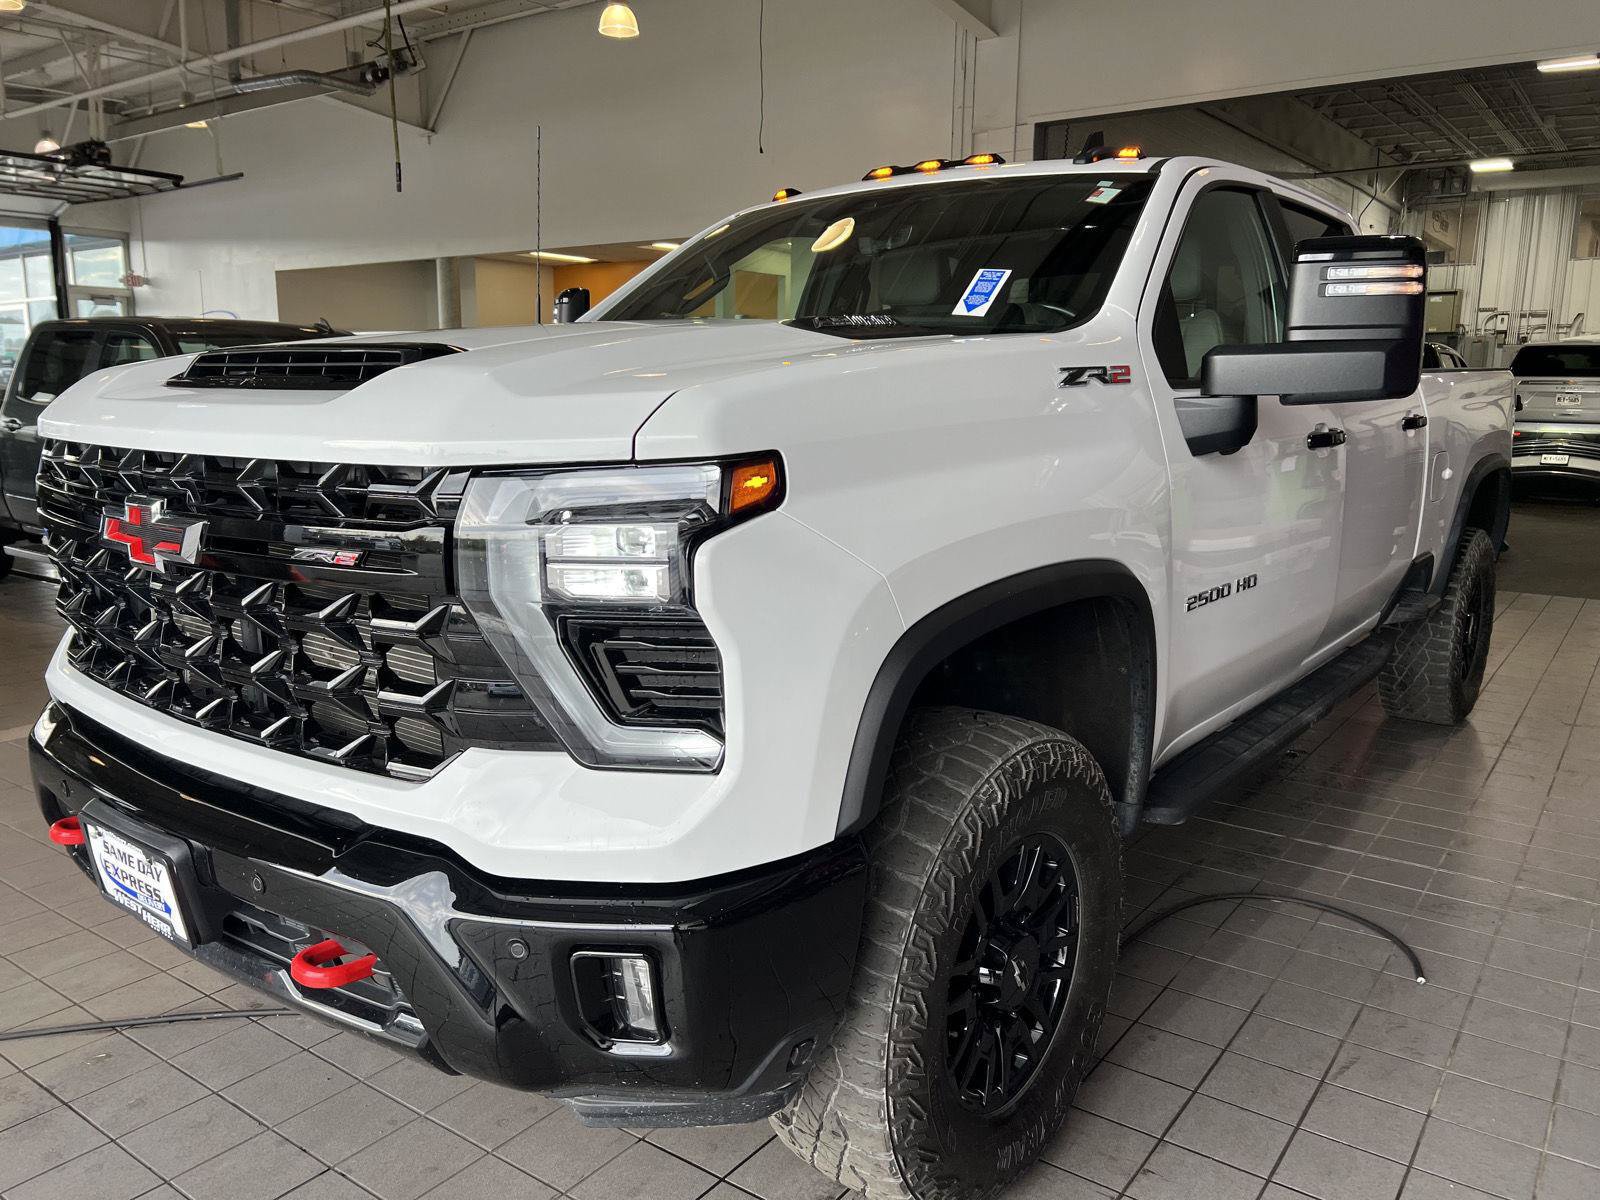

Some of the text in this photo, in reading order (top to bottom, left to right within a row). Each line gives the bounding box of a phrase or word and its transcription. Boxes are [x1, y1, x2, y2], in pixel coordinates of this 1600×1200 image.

[1057, 364, 1132, 388] ZR2
[290, 547, 361, 567] ZR2
[1185, 572, 1258, 613] 2500 HD
[103, 840, 136, 870] SAME
[137, 858, 162, 883] DAY
[103, 859, 162, 902] EXPRESS
[115, 892, 143, 914] WEST
